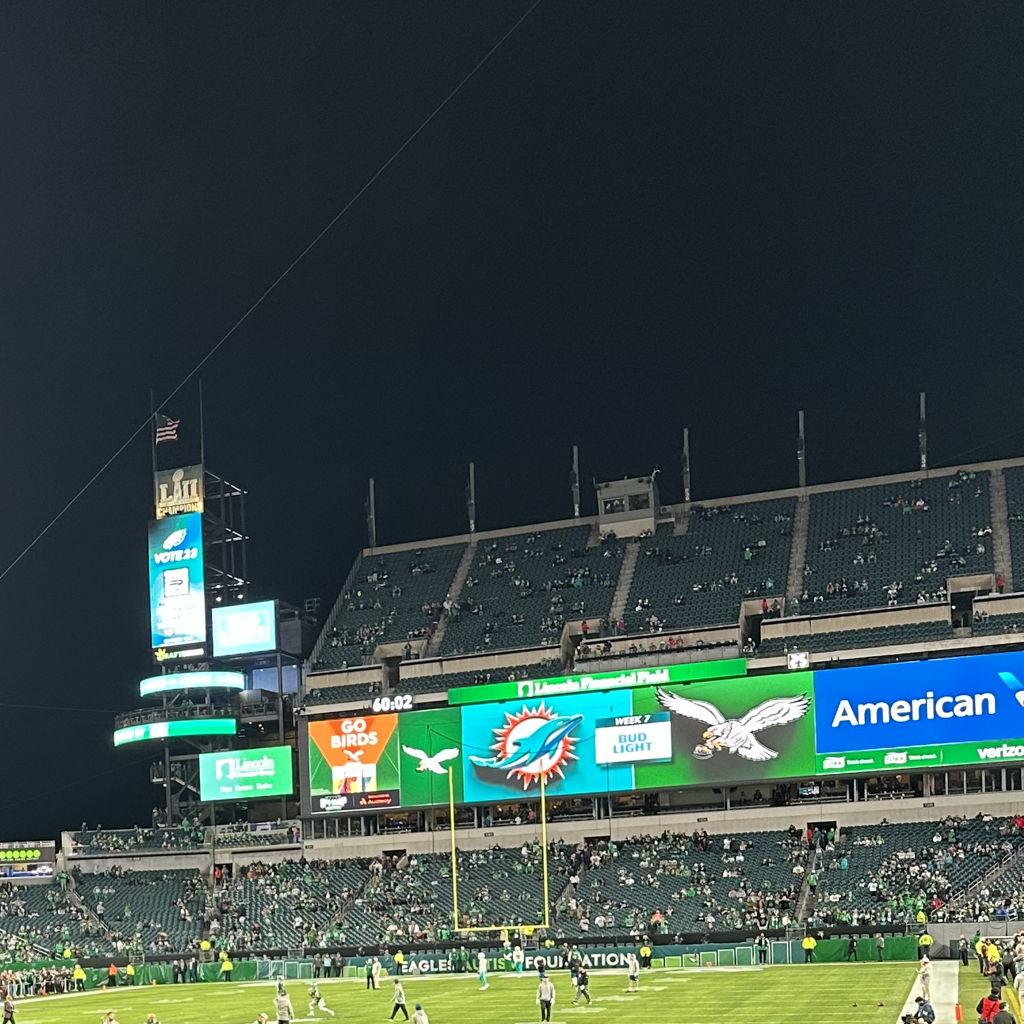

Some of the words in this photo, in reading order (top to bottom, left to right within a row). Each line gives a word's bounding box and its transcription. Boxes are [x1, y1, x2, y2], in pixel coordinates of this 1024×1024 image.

[373, 695, 413, 712] 60:02
[832, 691, 996, 728] American
[341, 719, 366, 733] GO
[615, 717, 641, 726] WEEK
[644, 715, 651, 724] 7
[330, 731, 378, 749] BIRDS
[618, 733, 647, 743] BUD
[613, 742, 653, 754] LIGHT
